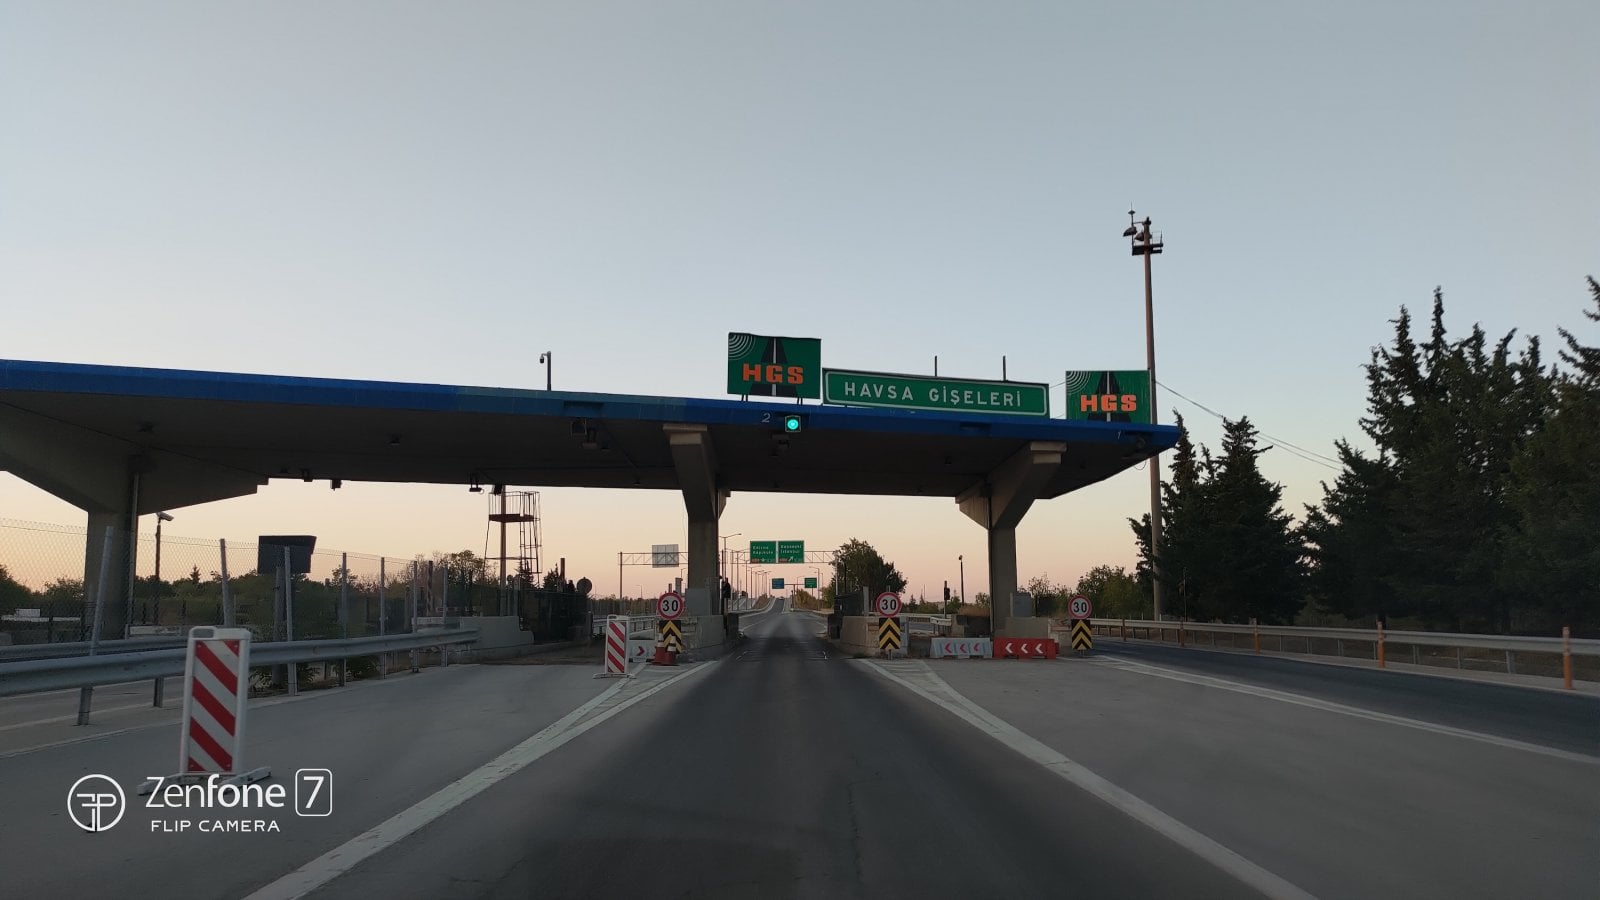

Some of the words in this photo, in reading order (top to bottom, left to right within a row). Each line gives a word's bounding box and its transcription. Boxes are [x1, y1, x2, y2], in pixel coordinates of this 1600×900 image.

[743, 363, 804, 385] HGS
[845, 381, 914, 401] HAVSA
[929, 385, 1022, 408] GİŞELERİ
[1080, 394, 1137, 412] HGS
[762, 412, 771, 423] 2
[663, 599, 679, 612] 30
[881, 599, 897, 610] 30
[1073, 601, 1087, 613] 30
